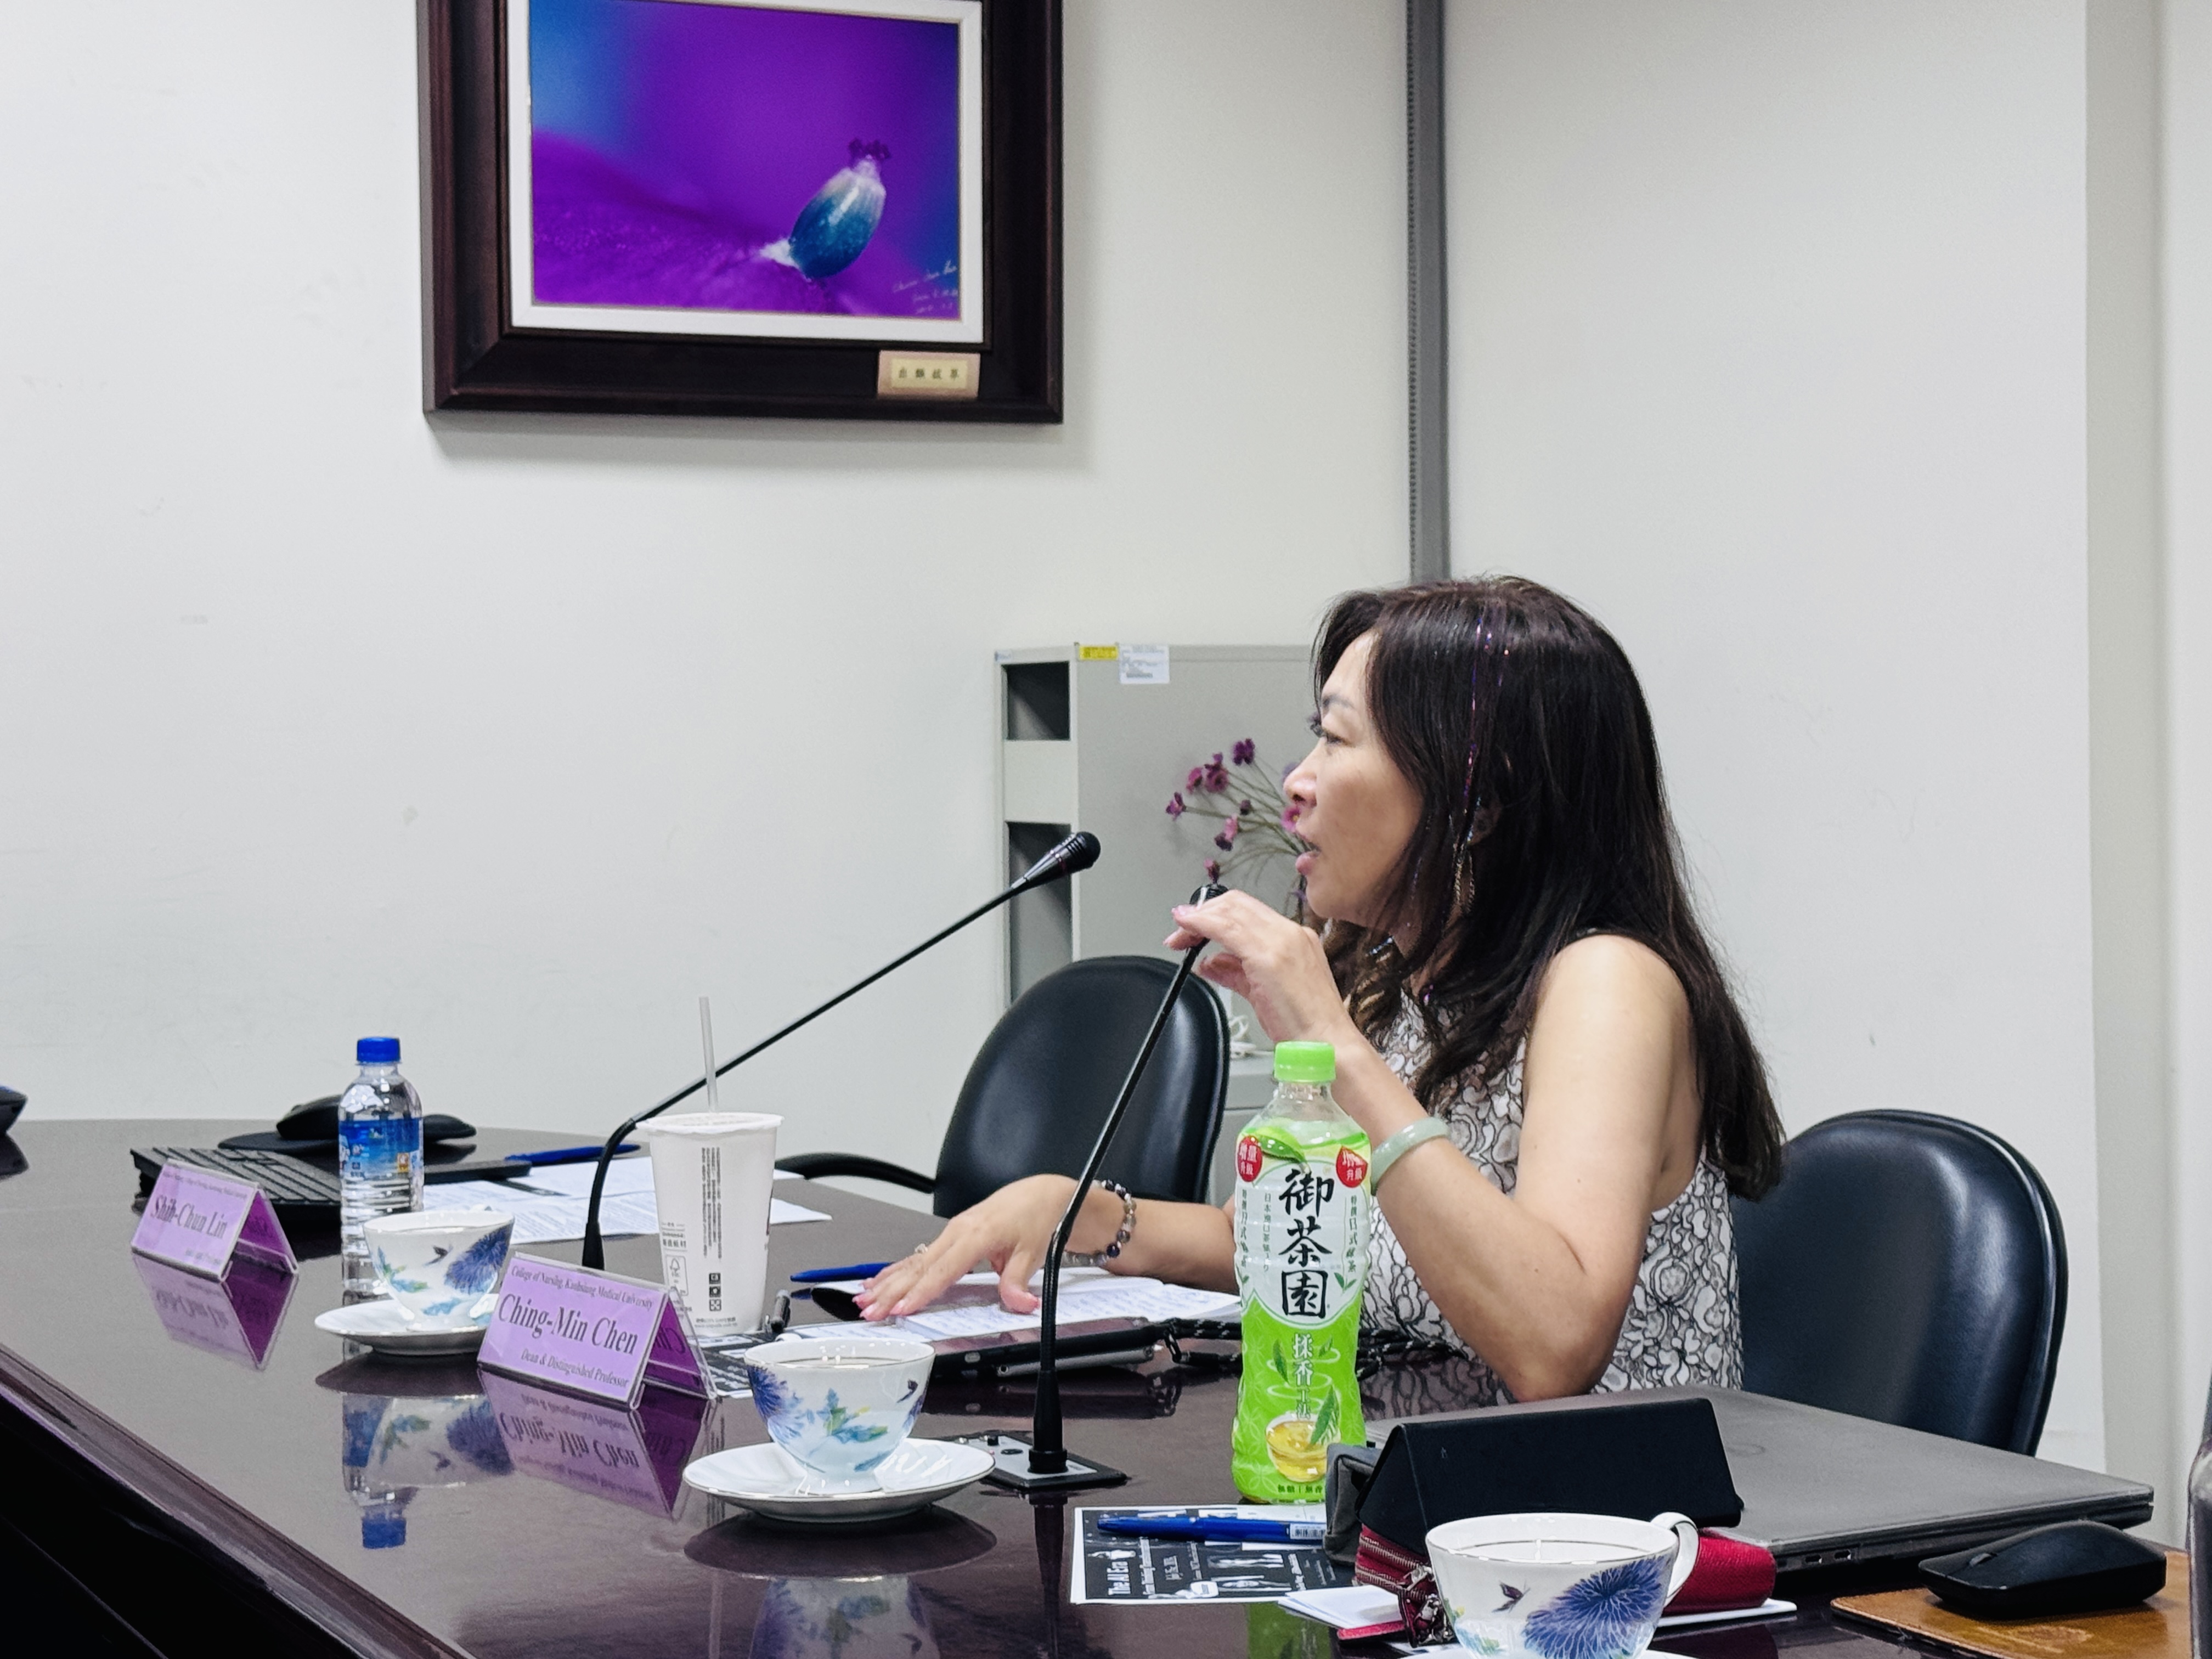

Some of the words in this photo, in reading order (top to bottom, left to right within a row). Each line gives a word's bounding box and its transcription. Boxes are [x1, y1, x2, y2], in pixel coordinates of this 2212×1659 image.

[151, 1194, 207, 1232] Shih-Chun
[206, 1211, 228, 1239] Lin
[1279, 1168, 1334, 1318] 御茶園
[511, 1265, 532, 1282] College
[499, 1294, 588, 1339] Ching-Min
[591, 1317, 639, 1356] Chen
[521, 1348, 539, 1363] Dean
[539, 1353, 548, 1365] &
[548, 1356, 595, 1378] Distinguished
[594, 1369, 629, 1388] Professor
